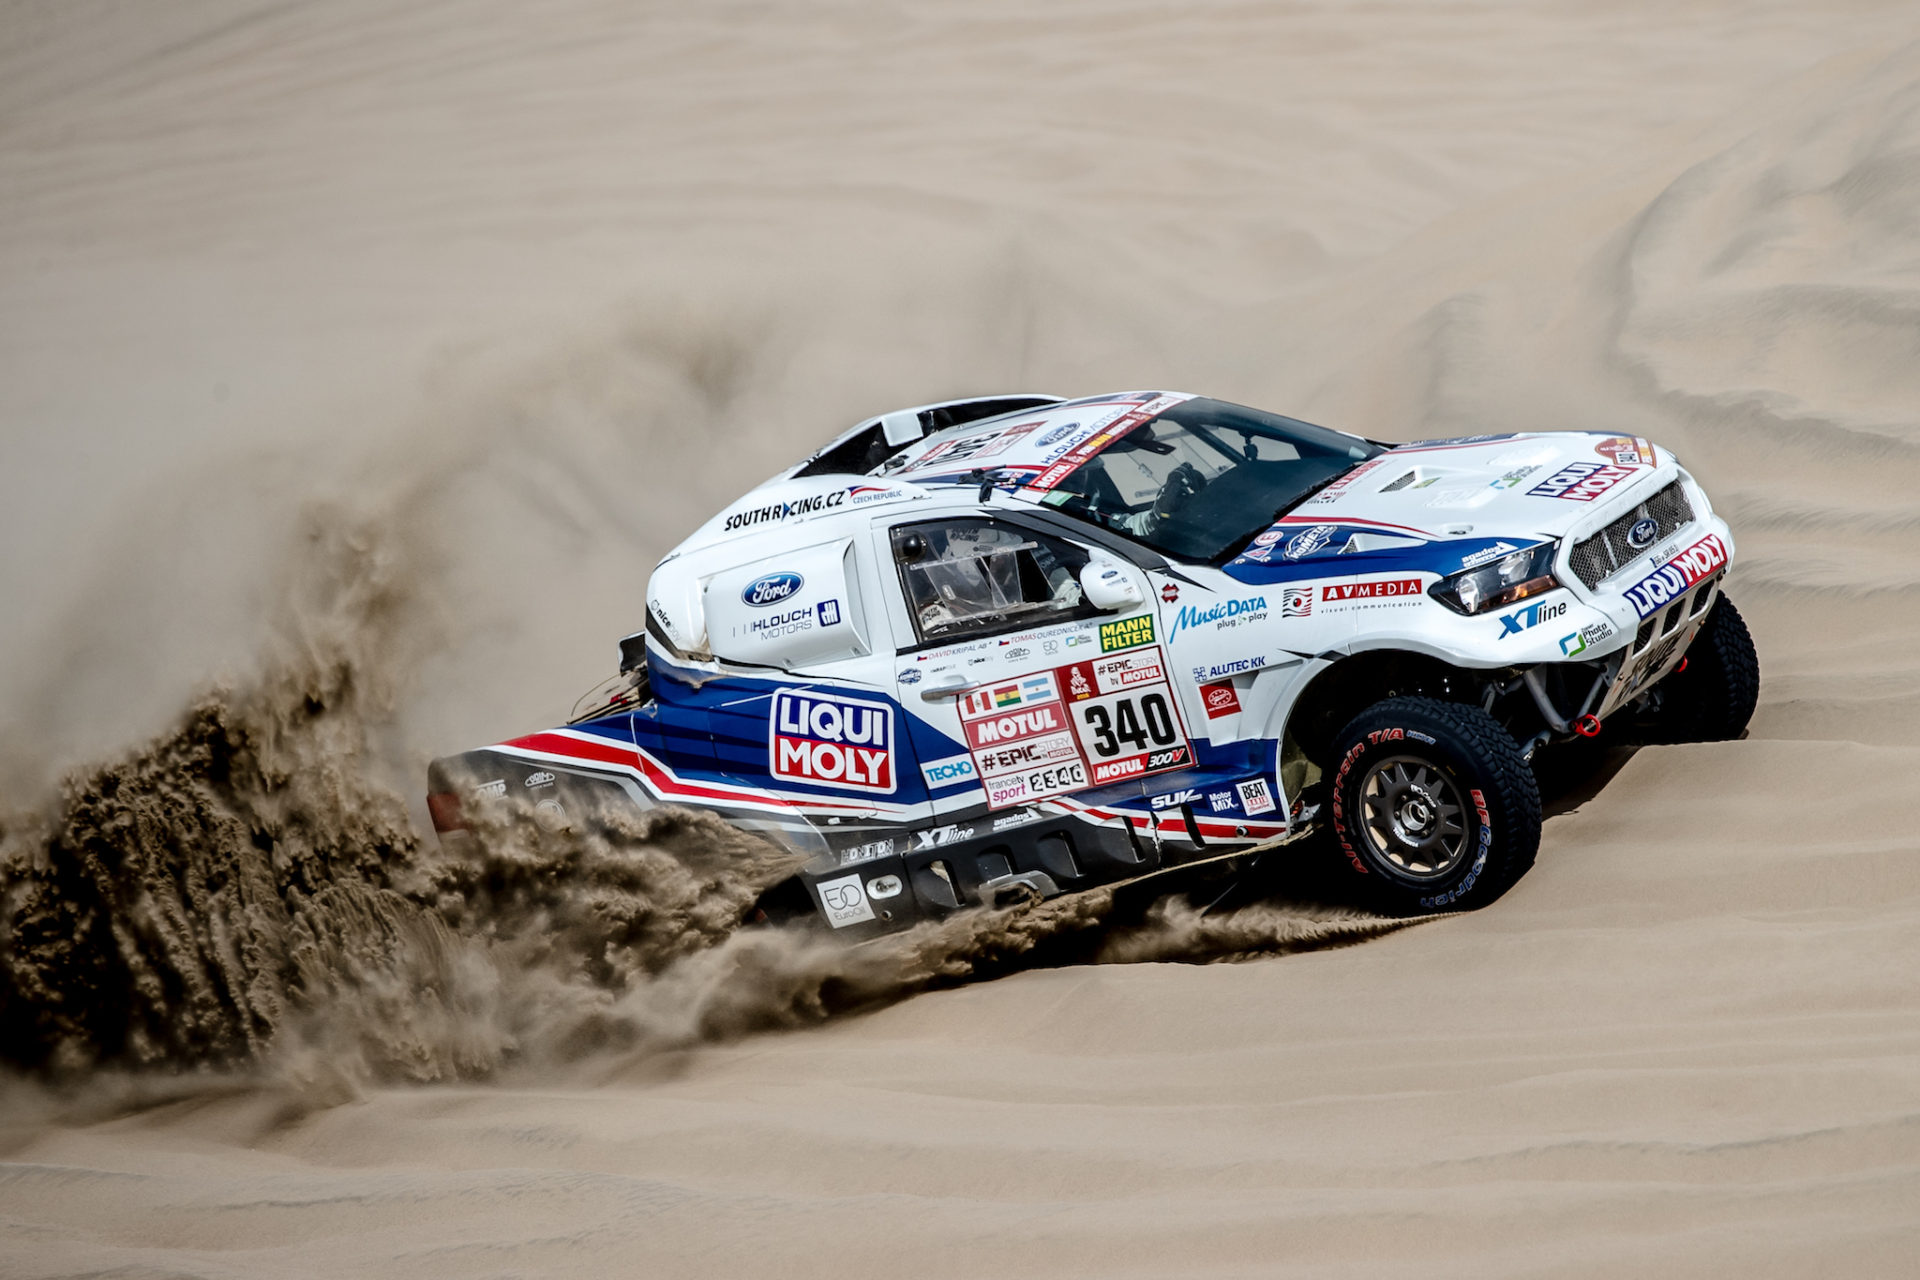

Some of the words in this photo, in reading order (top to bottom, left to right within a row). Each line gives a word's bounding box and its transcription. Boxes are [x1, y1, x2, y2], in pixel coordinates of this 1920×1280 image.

[1036, 463, 1072, 488] MOTUL
[1529, 462, 1603, 496] LIQUI
[1563, 465, 1632, 501] MOLY
[853, 494, 872, 504] CZECH
[873, 490, 902, 502] REPUBLIC
[1291, 526, 1329, 559] KOMETA
[1634, 522, 1656, 544] Ford
[1626, 563, 1687, 615] LIQUI
[1678, 534, 1727, 584] MOLY
[752, 577, 792, 603] Ford
[1351, 601, 1423, 611] communication
[753, 608, 812, 632] HLOUCH
[761, 620, 812, 641] MOTORS
[1102, 616, 1151, 638] MANN
[1217, 618, 1236, 631] plug
[1249, 611, 1268, 624] play
[1011, 632, 1037, 644] TOMAS
[1103, 630, 1153, 651] FILTER
[1583, 623, 1608, 640] Photo
[1586, 628, 1613, 647] Studio
[928, 649, 951, 660] DAVID
[1110, 678, 1119, 687] by
[1122, 667, 1161, 684] MOTUL
[1210, 659, 1250, 677] ALUTEC
[1251, 655, 1267, 668] KK
[779, 696, 884, 746] LIQUI
[977, 708, 1058, 745] MOTUL
[1083, 692, 1178, 757] 340
[1368, 728, 1404, 745] T/A
[779, 738, 888, 785] MOLY
[925, 760, 972, 783] TECHO
[1097, 758, 1145, 781] MOTUL
[1148, 748, 1185, 769] 300V
[993, 783, 1026, 804] sport
[1209, 791, 1232, 802] Motor
[1241, 782, 1266, 799] BEAT
